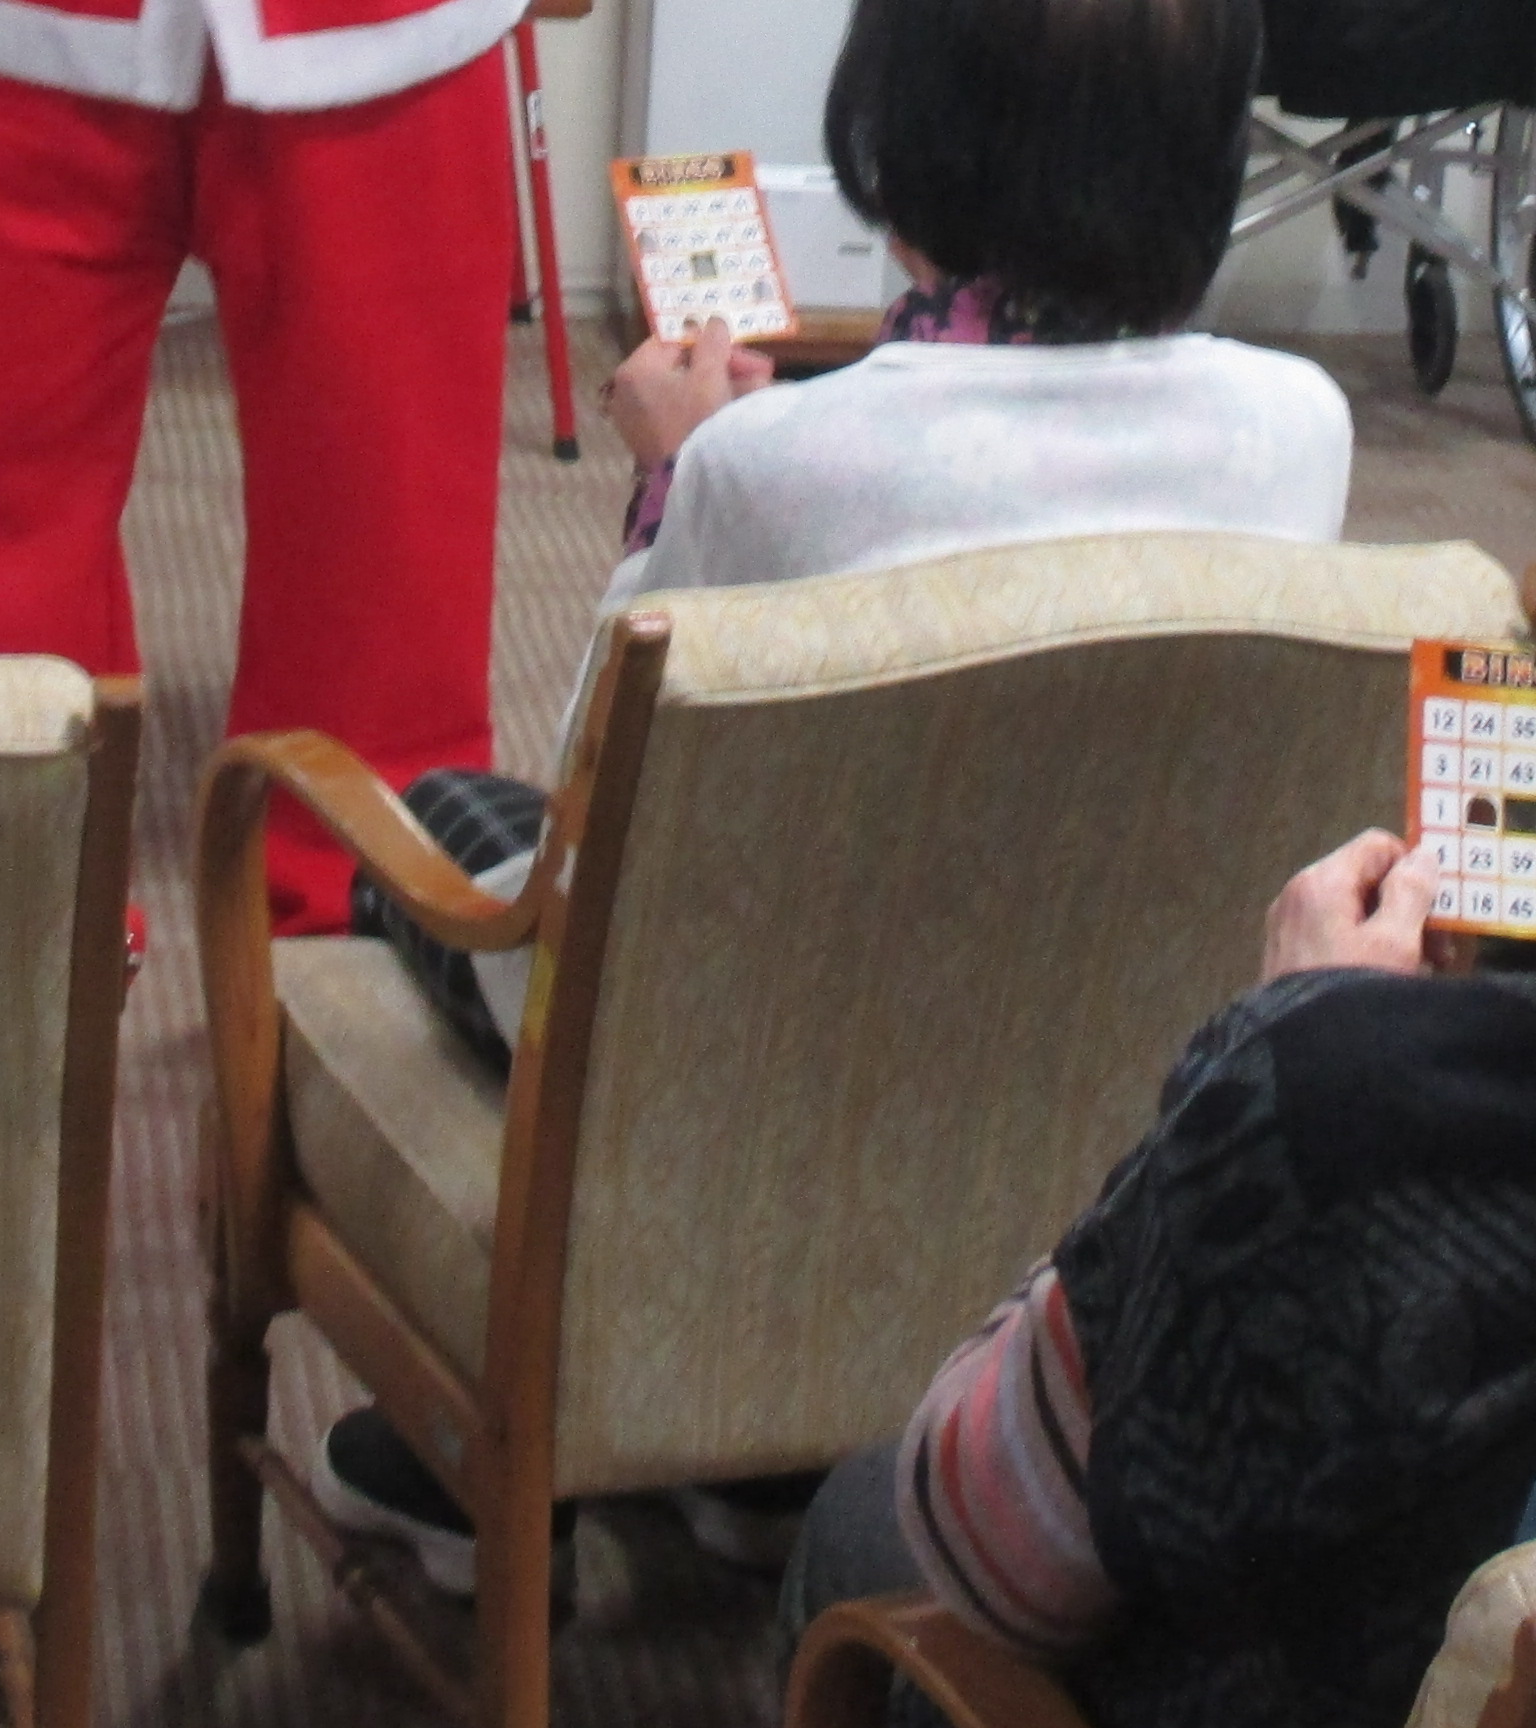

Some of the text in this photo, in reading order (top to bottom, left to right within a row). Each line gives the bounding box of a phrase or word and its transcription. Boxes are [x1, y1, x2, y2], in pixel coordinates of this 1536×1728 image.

[1432, 706, 1536, 739] 12 24 35
[1469, 756, 1494, 782] 21
[1509, 760, 1535, 784] 43
[1468, 845, 1494, 870] 23
